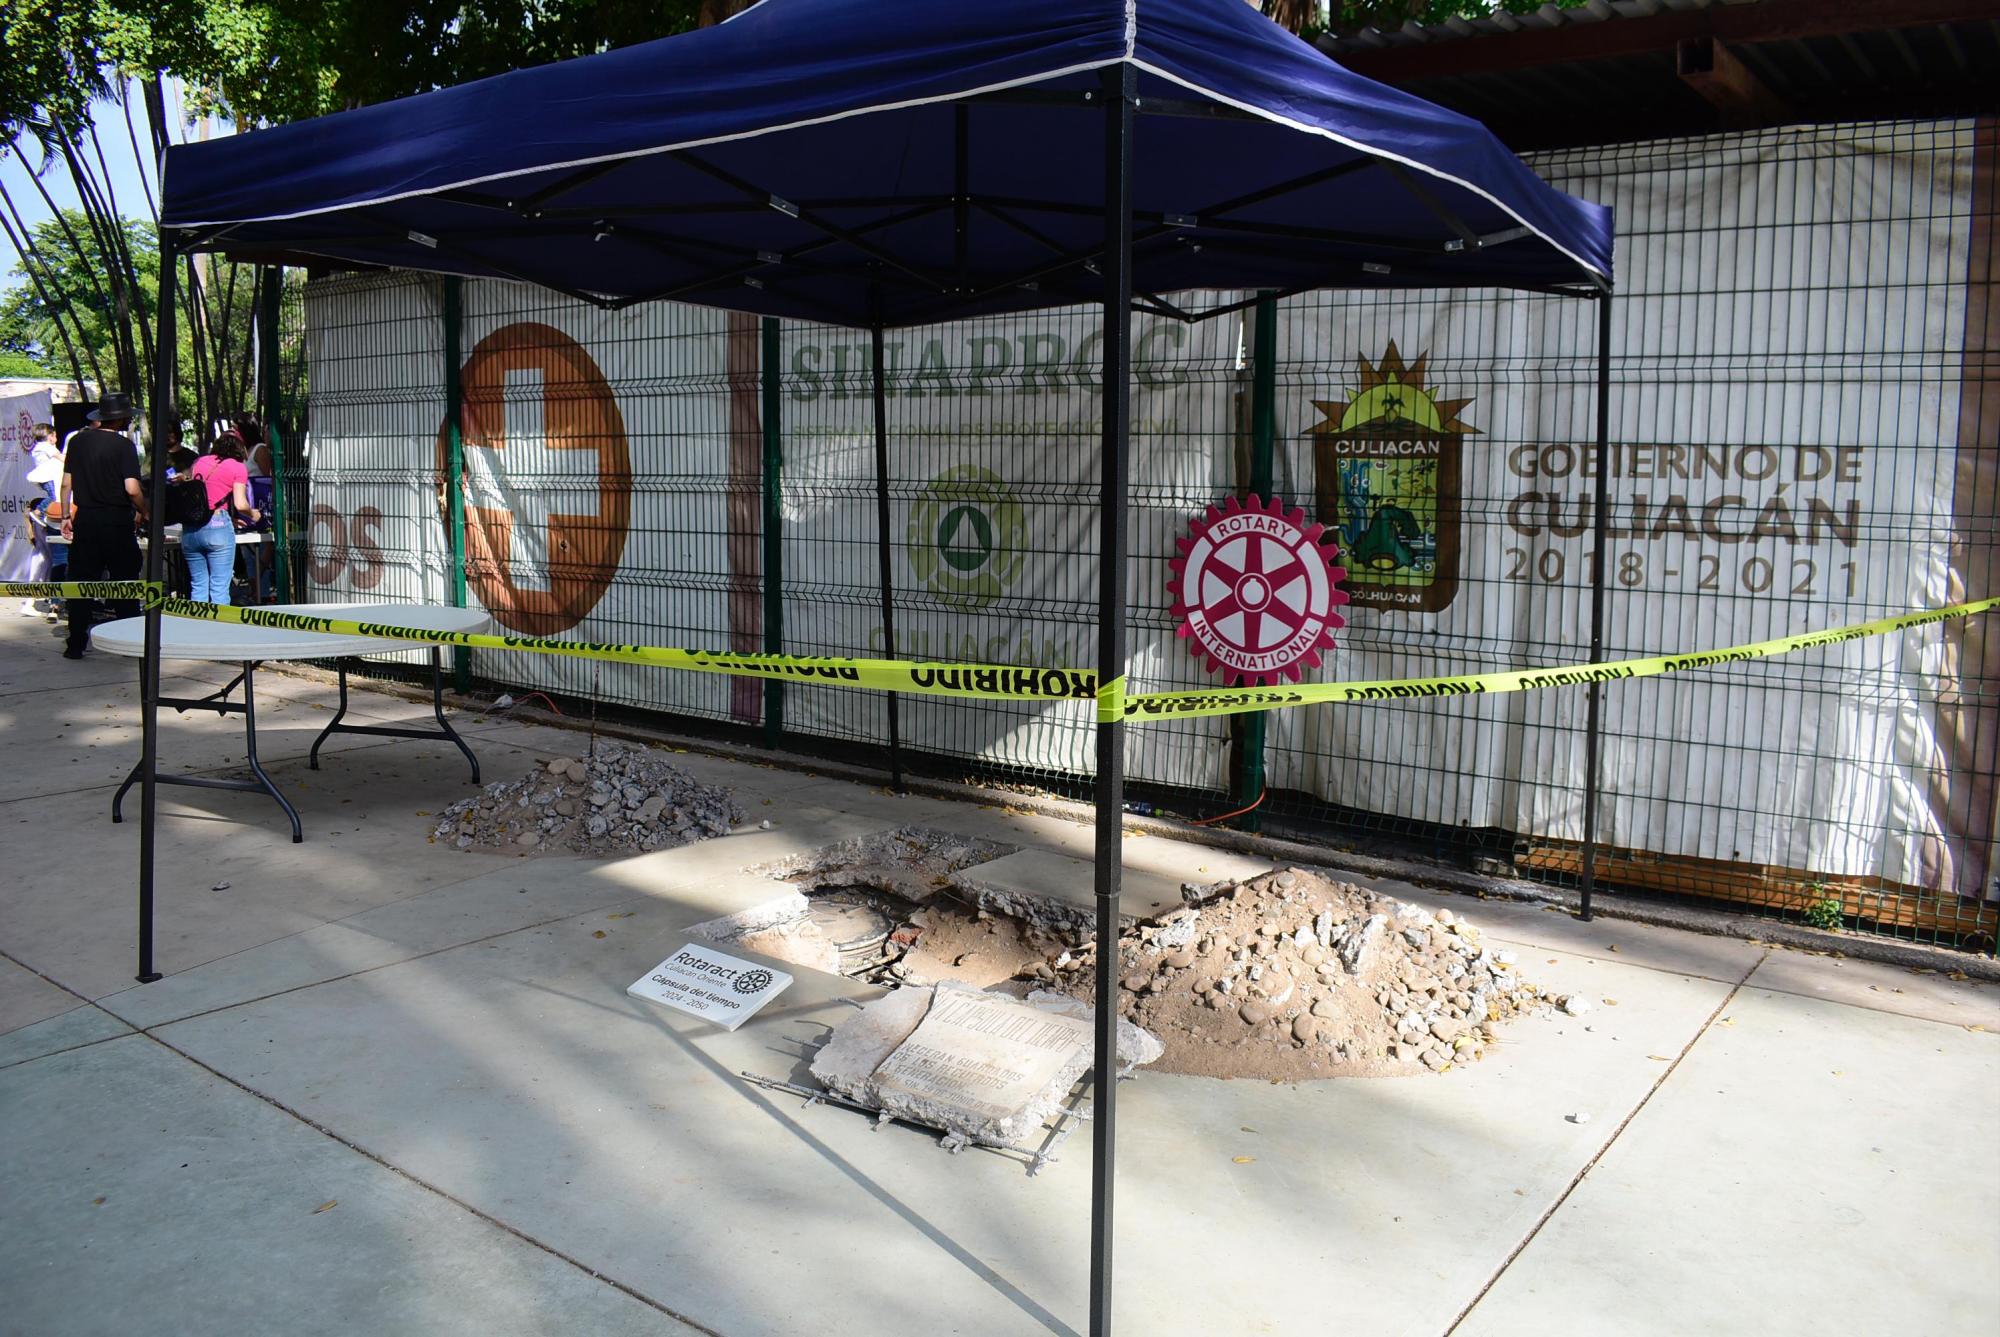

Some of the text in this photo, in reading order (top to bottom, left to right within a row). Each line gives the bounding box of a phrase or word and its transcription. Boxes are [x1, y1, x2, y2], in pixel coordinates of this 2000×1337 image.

[991, 416, 1103, 438] PROTECCIÓ
[1336, 440, 1440, 455] CULIACAN
[1508, 443, 1864, 483] GOBIERNO DE
[1217, 515, 1293, 539] ROTARY
[1506, 483, 1862, 548] CULIACÁN
[1504, 547, 1858, 598] 2018-2021
[1193, 619, 1319, 670] INTERNATIONAL
[910, 663, 1098, 699] ROHIBIDO
[674, 951, 738, 980] Rotaract
[689, 987, 708, 998] del
[705, 992, 741, 1010] tiempo
